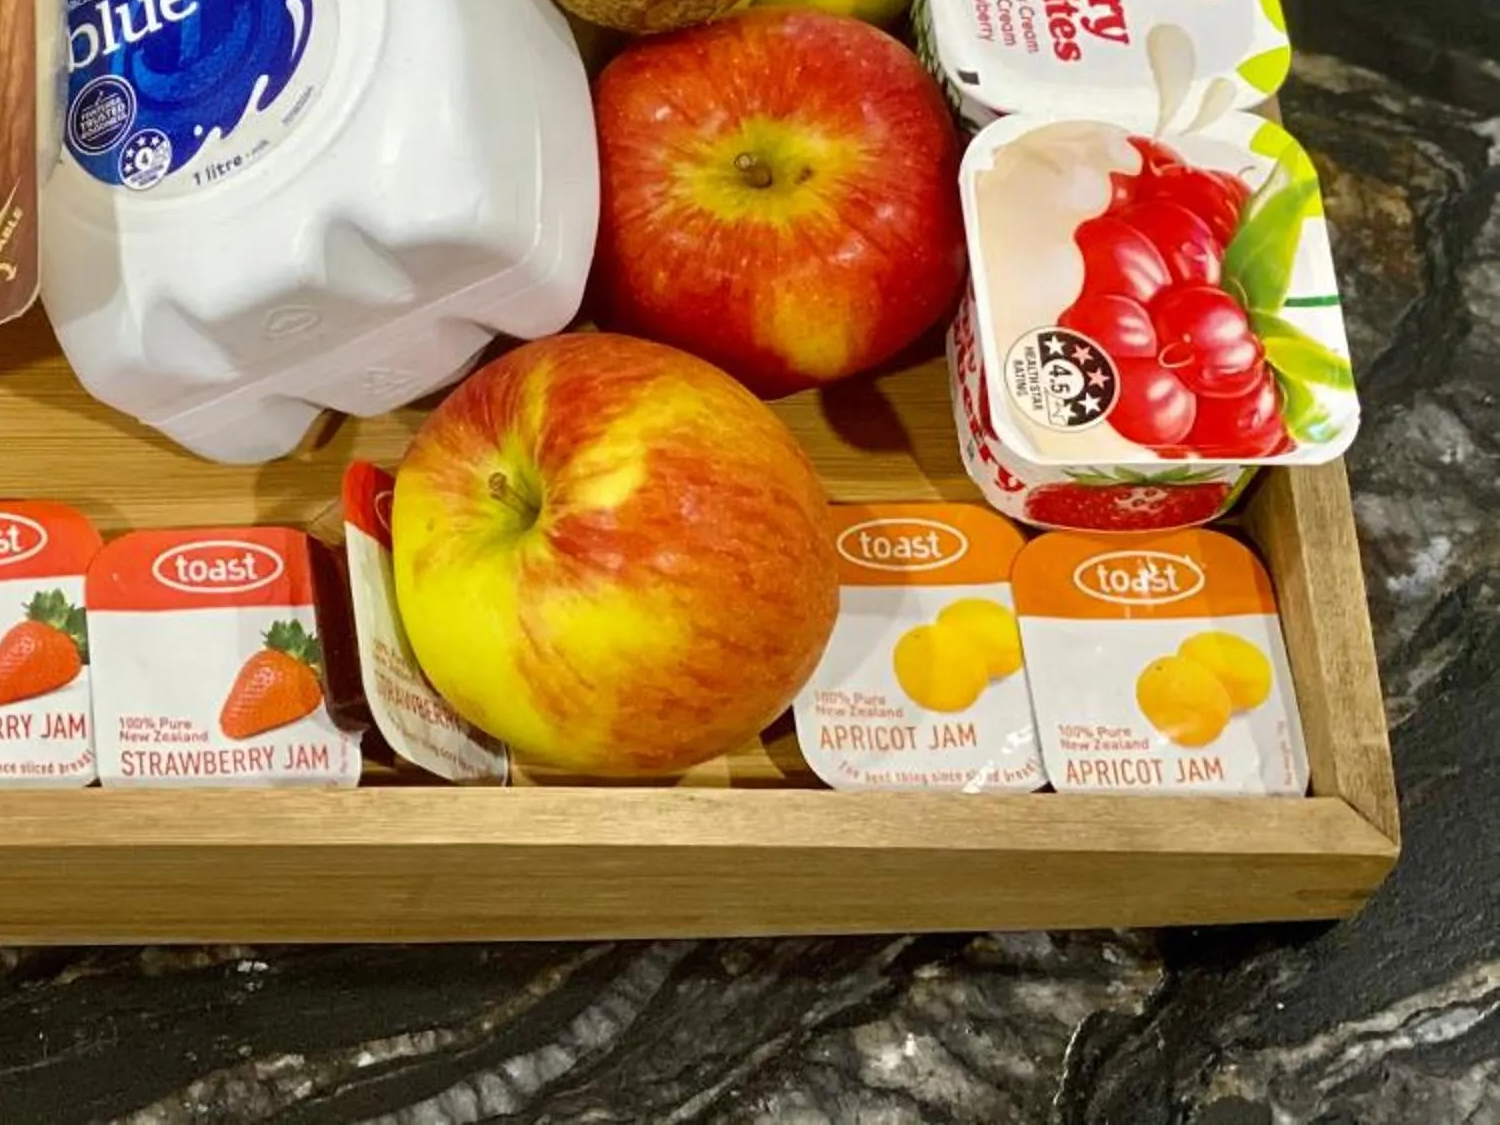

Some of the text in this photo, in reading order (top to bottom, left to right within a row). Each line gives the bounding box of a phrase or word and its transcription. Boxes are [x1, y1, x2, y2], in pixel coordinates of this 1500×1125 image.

[1018, 5, 1041, 55] Cream
[193, 155, 243, 186] 1 litre
[1048, 362, 1071, 396] 4.5
[860, 529, 942, 560] toast
[175, 553, 259, 583] toast
[1097, 564, 1181, 593] toast
[40, 713, 87, 740] JAM
[159, 716, 193, 730] Pure
[850, 706, 904, 719] Zealand
[119, 729, 209, 743] New Zealand
[820, 722, 978, 751] APRICOT JAM
[1094, 738, 1150, 751] Zealand
[121, 746, 276, 777] STRAWBERRY
[283, 743, 330, 771] JAM
[1065, 756, 1225, 786] APRICOT JAM
